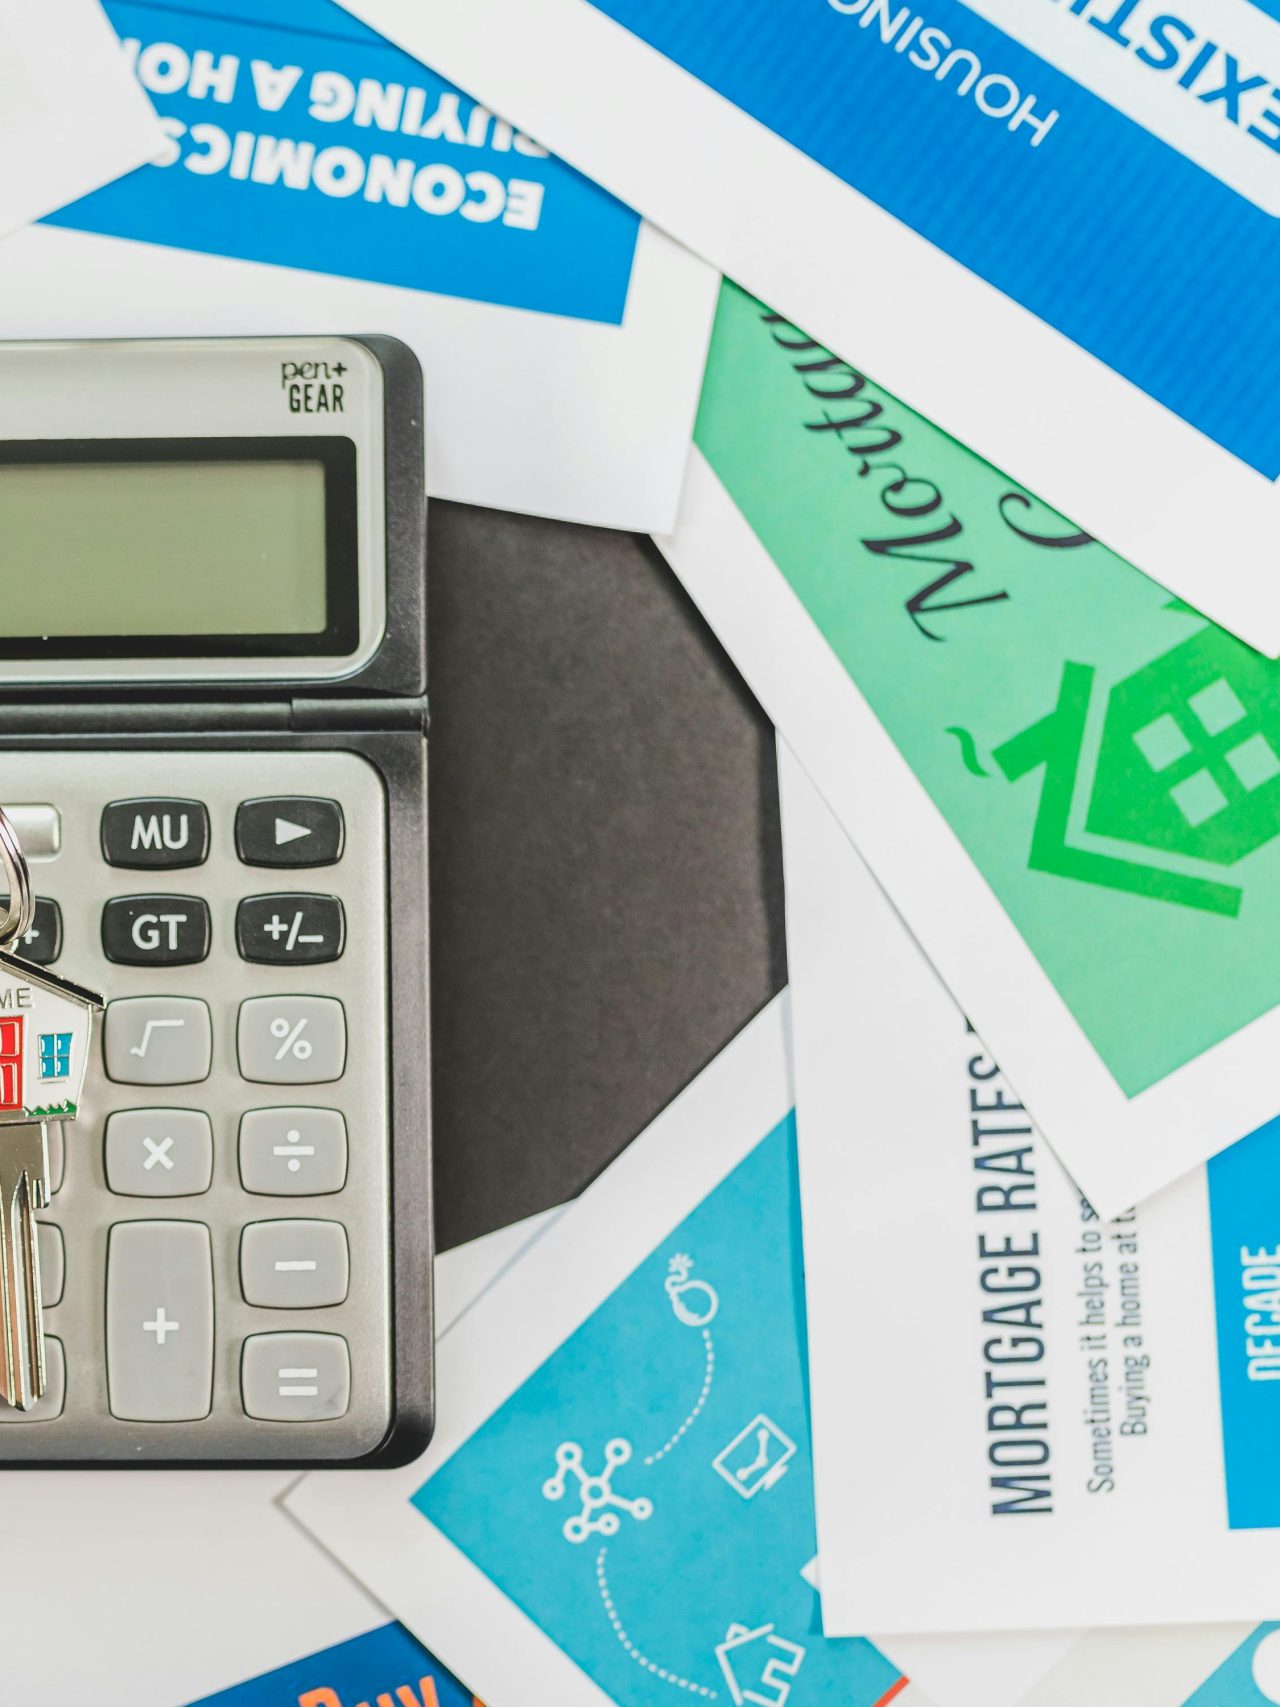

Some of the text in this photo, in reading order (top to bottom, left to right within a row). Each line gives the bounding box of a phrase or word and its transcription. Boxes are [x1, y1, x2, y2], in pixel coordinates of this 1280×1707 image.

[250, 58, 305, 113] A
[830, 0, 1060, 147] HOUSIN
[308, 70, 550, 159] UYING
[288, 383, 344, 413] GEAR
[130, 813, 189, 850] MU
[131, 913, 188, 951] GT
[1074, 1231, 1102, 1254] to
[1110, 1231, 1139, 1254] at
[1076, 1261, 1110, 1327] helps
[1115, 1262, 1143, 1328] home
[1079, 1333, 1108, 1352] it
[1124, 1335, 1143, 1349] a
[977, 1231, 1054, 1518] MORTGAGE
[1118, 1353, 1151, 1437] Buying
[1084, 1357, 1115, 1494] Sometimes
